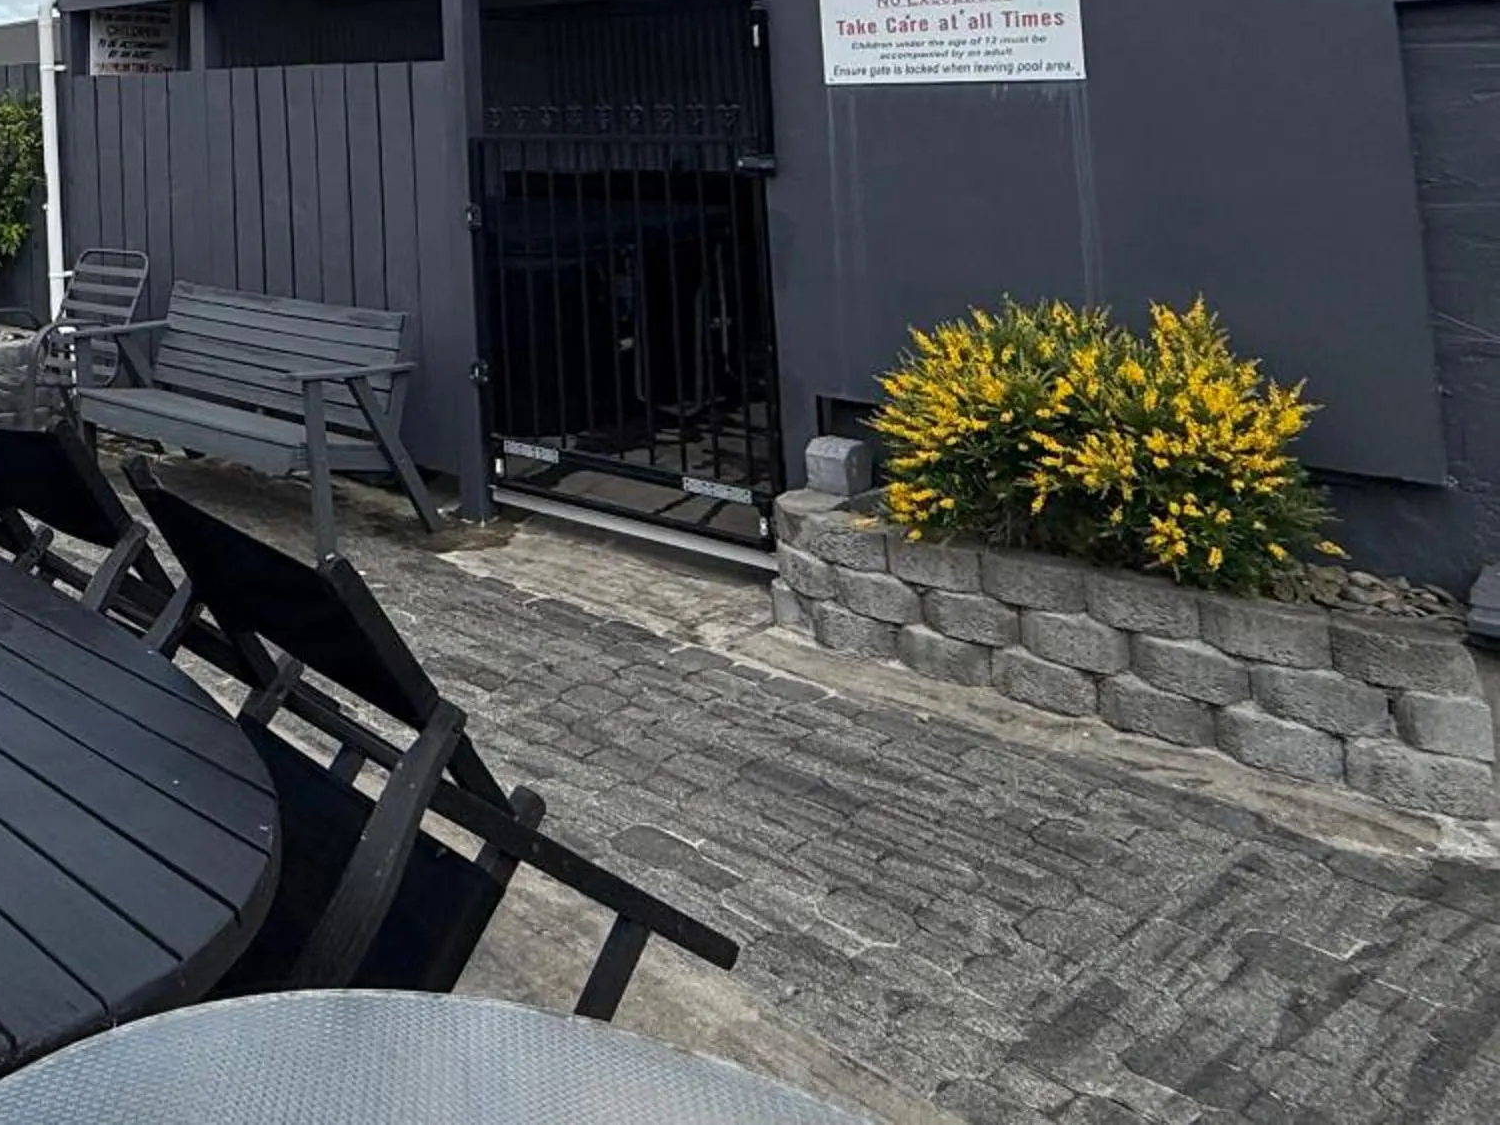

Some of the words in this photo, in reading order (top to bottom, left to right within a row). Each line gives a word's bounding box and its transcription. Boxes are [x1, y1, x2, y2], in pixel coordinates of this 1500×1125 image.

[836, 20, 877, 35] Take
[885, 16, 929, 33] Care
[939, 13, 958, 31] at
[968, 12, 992, 30] all
[1002, 10, 1064, 28] Times
[833, 65, 866, 77] Ensure
[869, 66, 891, 77] gate
[893, 65, 903, 75] is
[905, 63, 940, 75] locked
[942, 62, 971, 73] when
[973, 60, 1015, 75] leaving
[1016, 59, 1043, 74] pool
